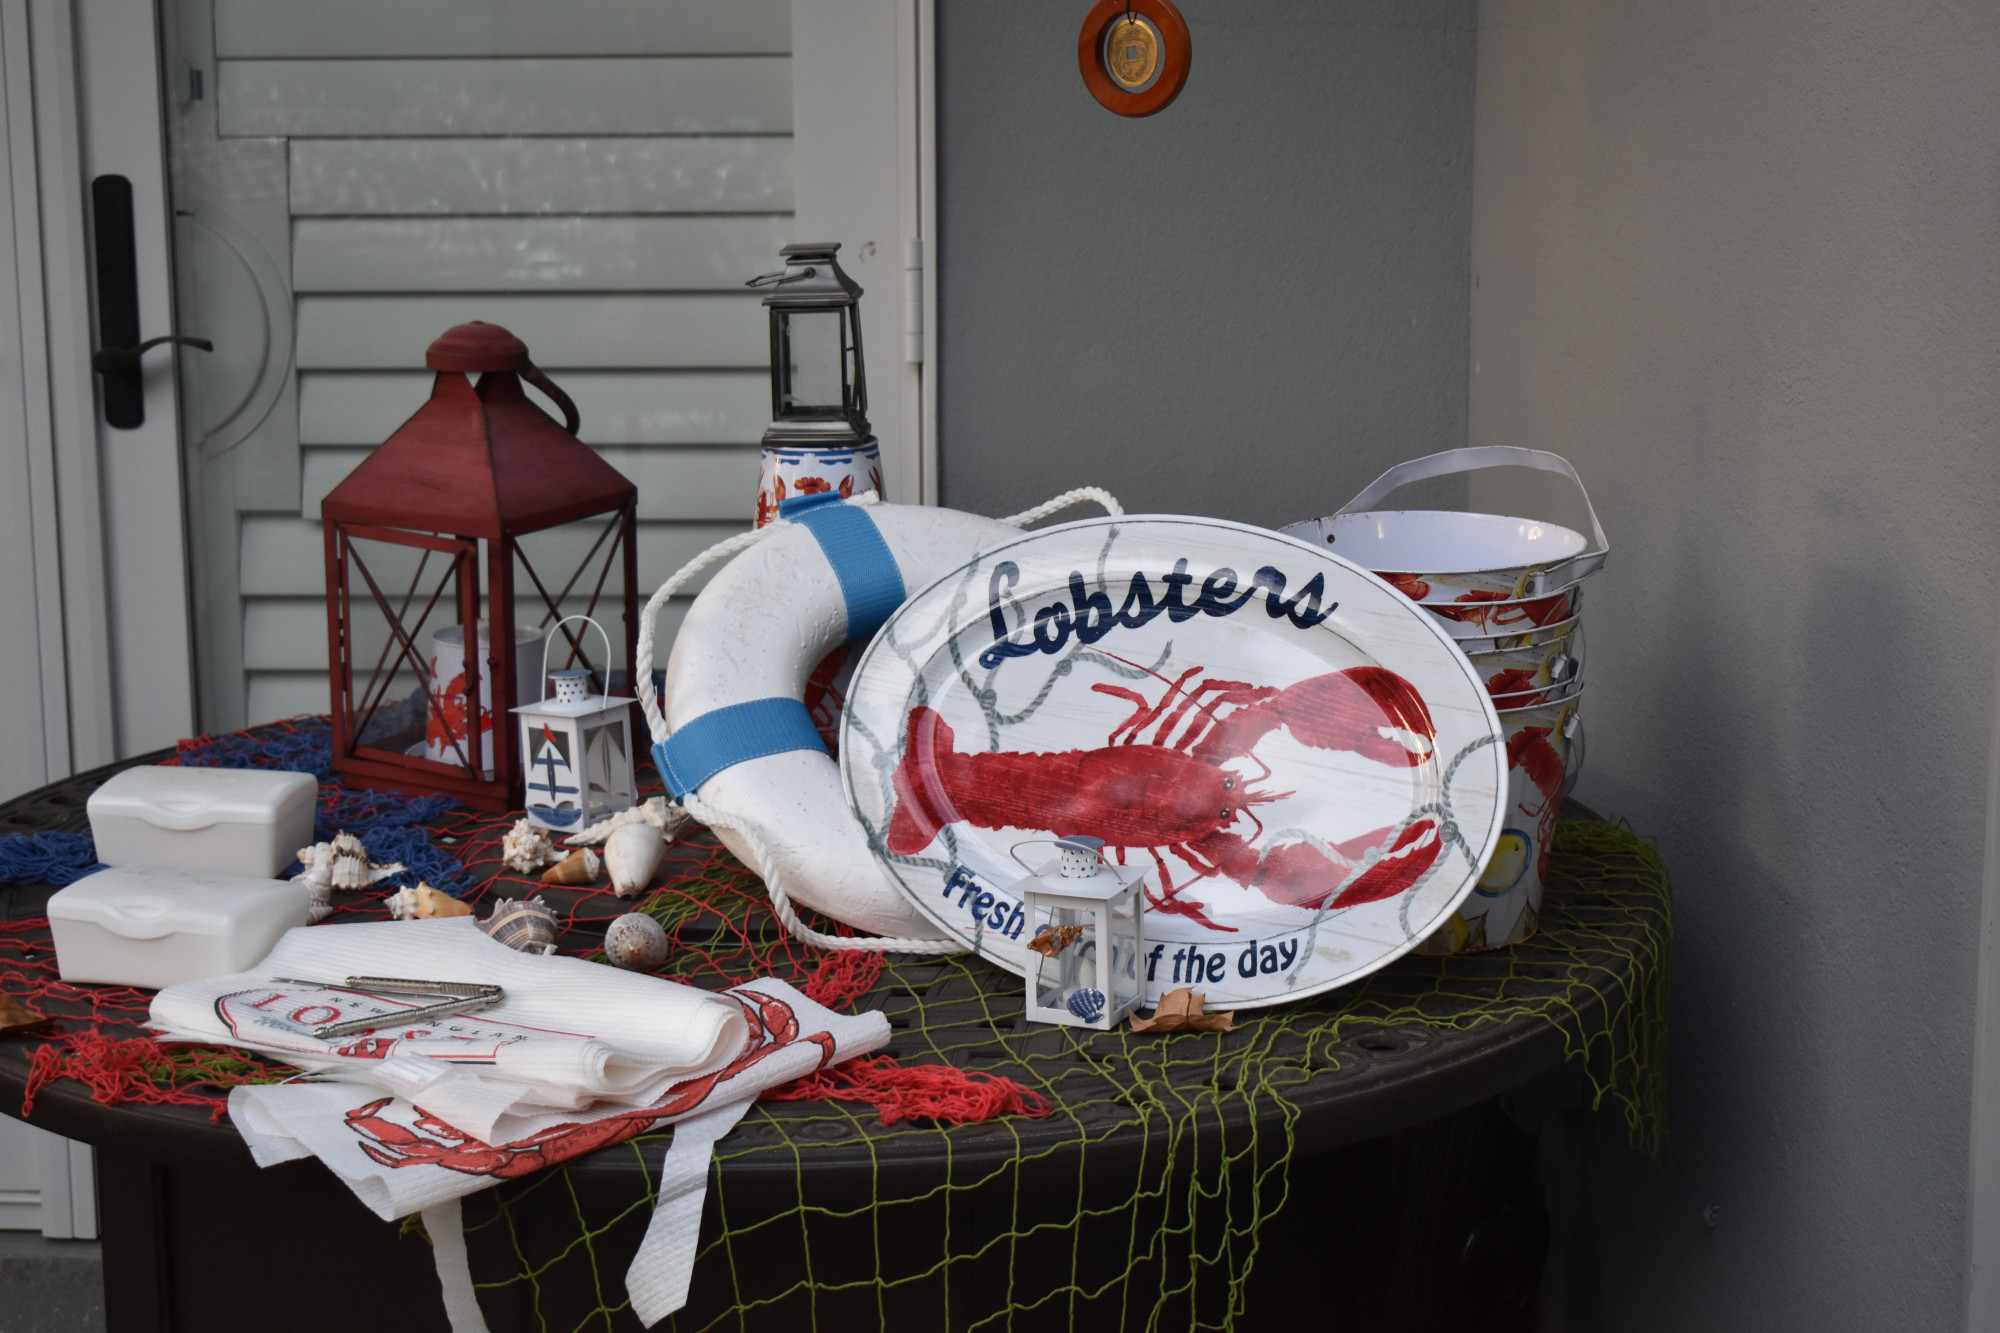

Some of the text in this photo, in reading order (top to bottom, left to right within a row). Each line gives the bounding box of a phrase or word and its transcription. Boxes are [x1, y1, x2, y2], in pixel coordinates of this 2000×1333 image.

[979, 557, 1339, 669] Lobsters
[943, 865, 1025, 940] Fresh
[1173, 945, 1226, 984] the
[1238, 938, 1298, 979] day
